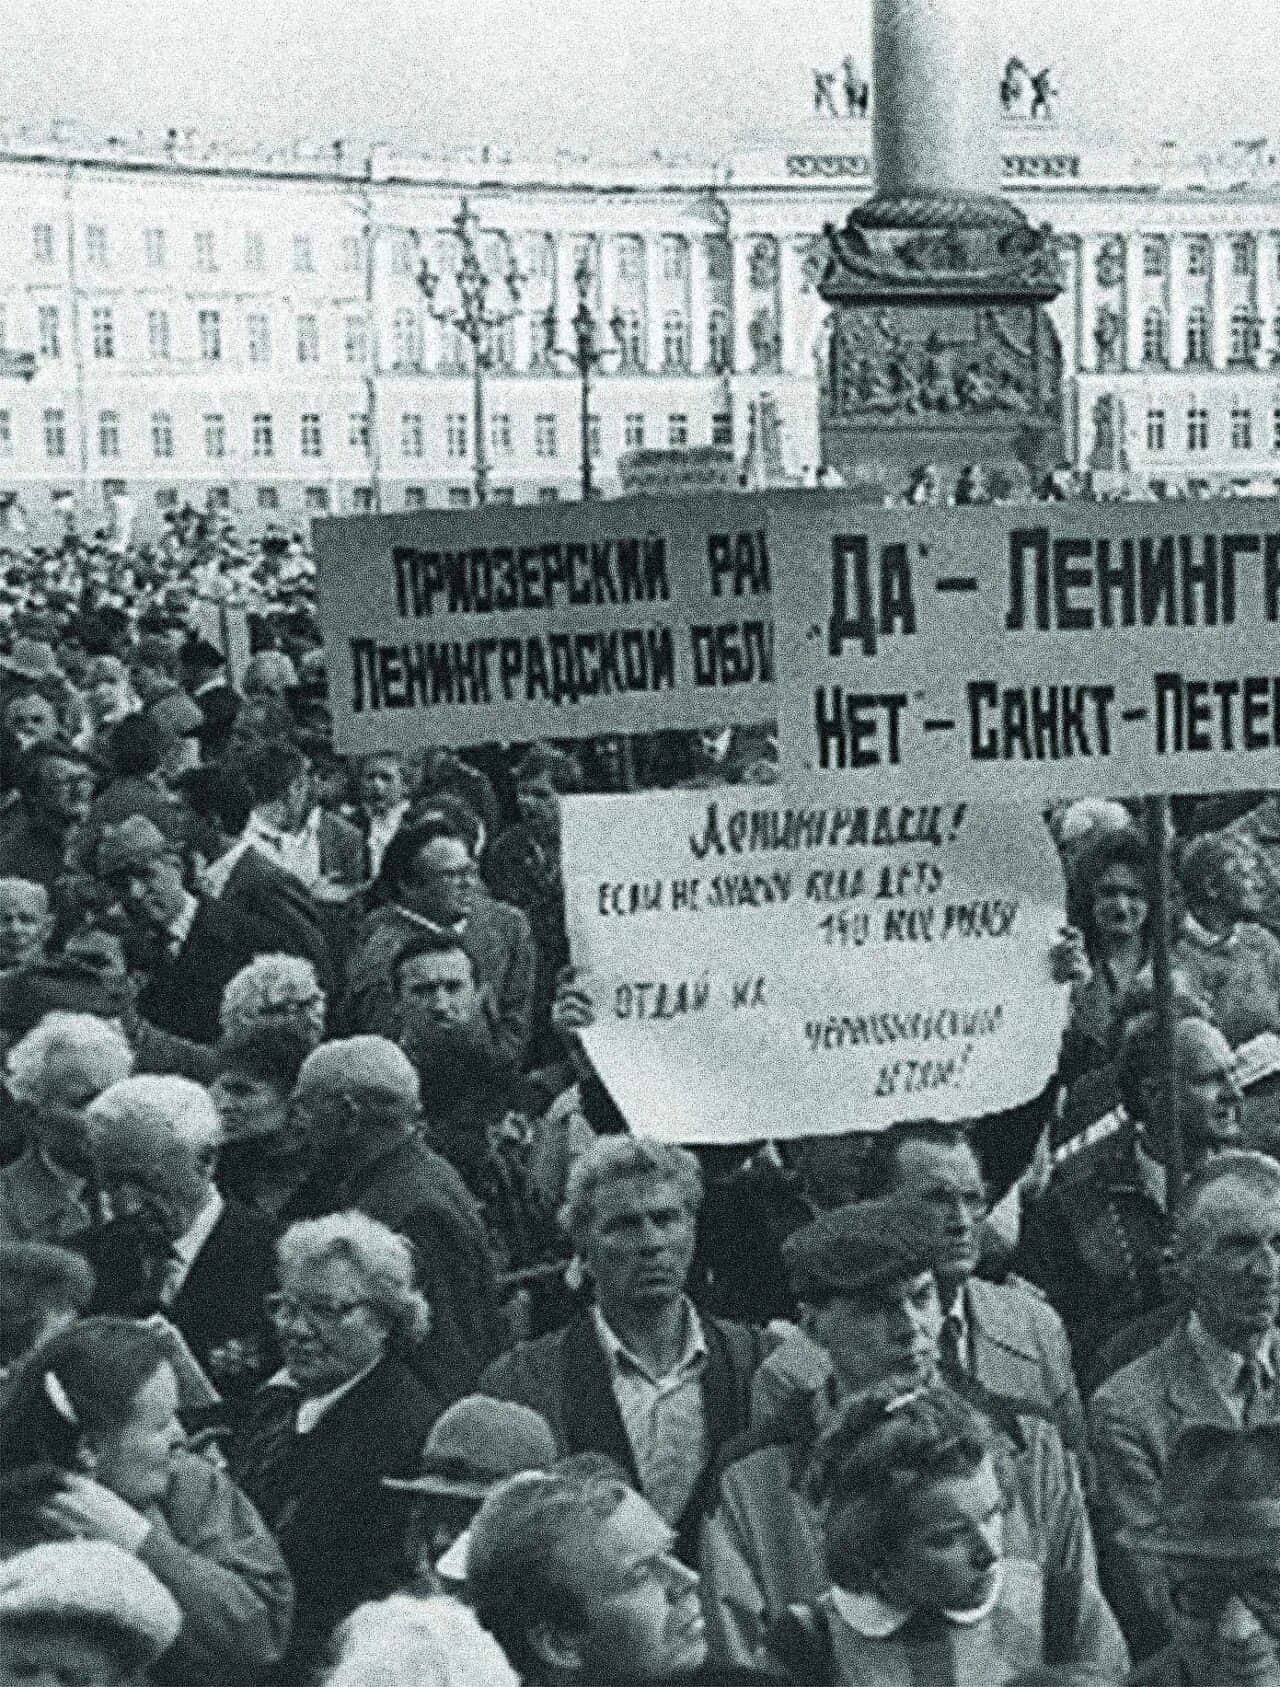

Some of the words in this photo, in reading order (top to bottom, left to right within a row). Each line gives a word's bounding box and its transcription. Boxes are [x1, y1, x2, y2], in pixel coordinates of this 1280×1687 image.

[391, 531, 670, 618] ПРИОЗЕРСКИЙ
[828, 533, 917, 657] ДА
[349, 621, 675, 713] ЛЕНИНГРАДСКОЙ
[690, 620, 773, 687] ОБЛ
[814, 685, 908, 769] НЕТ
[598, 880, 663, 916] ЕСЛИ
[671, 878, 701, 911] НЕ
[614, 970, 709, 1020] ОТДАЙ
